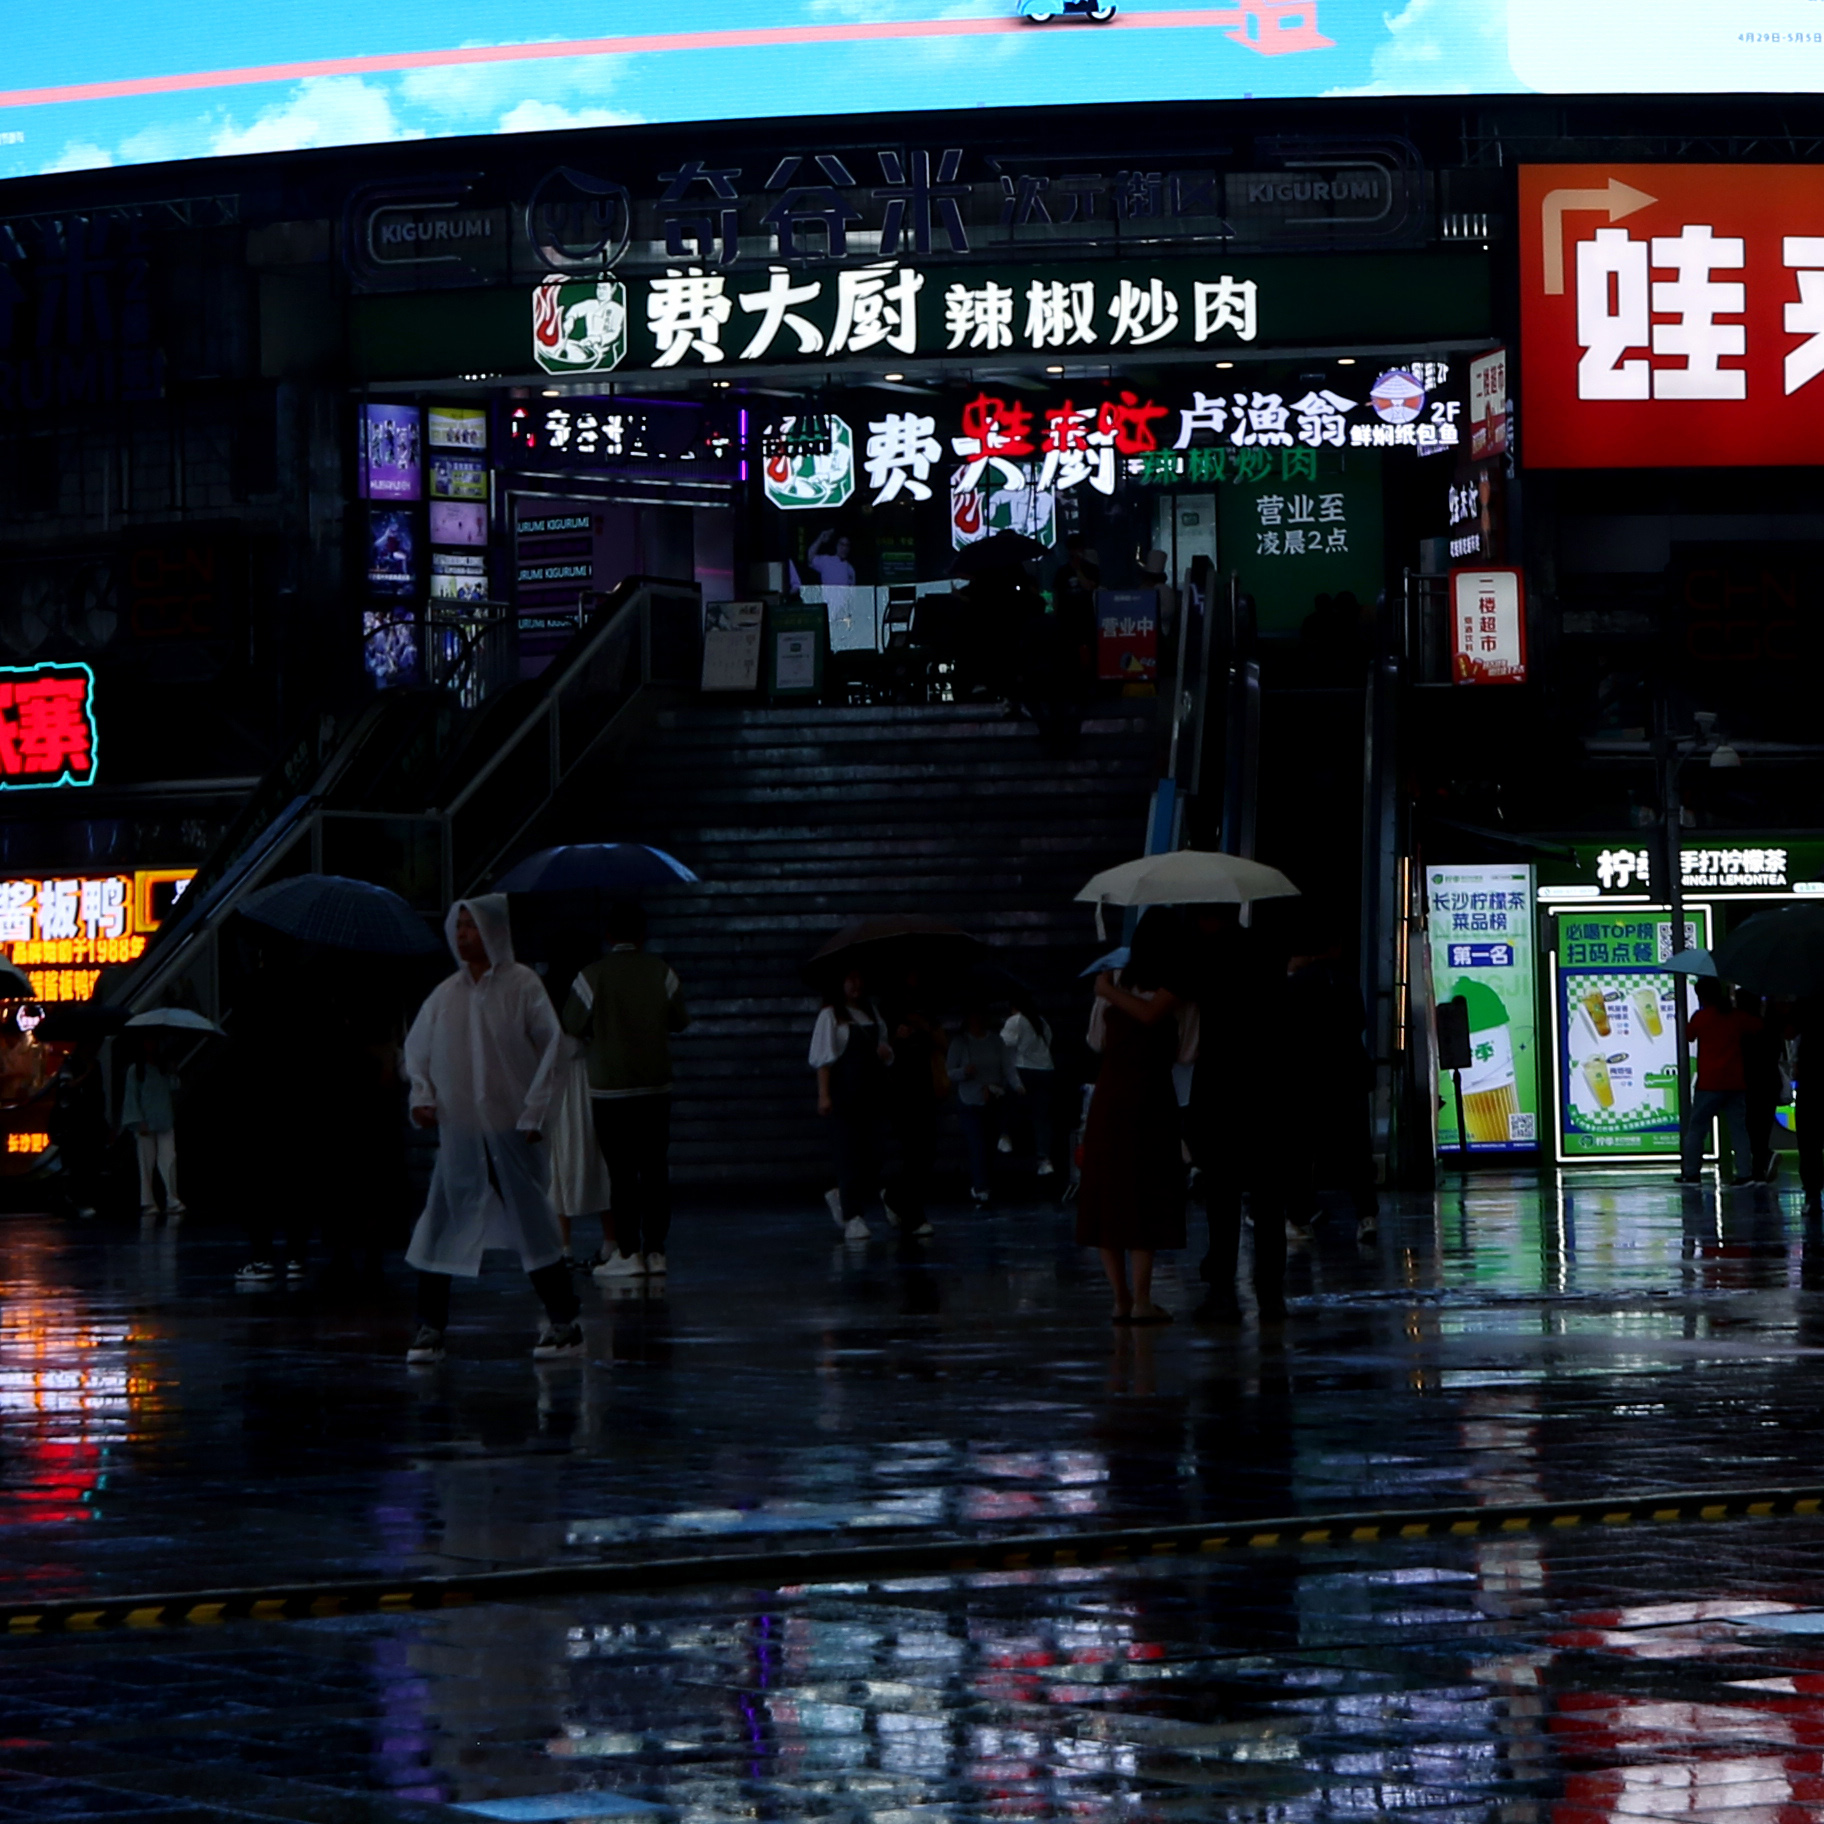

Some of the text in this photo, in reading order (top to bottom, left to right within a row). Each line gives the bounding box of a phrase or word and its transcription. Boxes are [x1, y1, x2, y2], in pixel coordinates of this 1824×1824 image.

[1248, 180, 1379, 204] KIGURUMI
[653, 148, 972, 266] 奇谷米
[381, 219, 492, 246] KIGURUMI
[646, 260, 925, 369] 费大厨
[944, 274, 1259, 351] 辣椒炒肉
[1431, 400, 1462, 422] 2F
[1256, 493, 1347, 526] 营业至
[1256, 528, 1350, 557] 凌晨2点
[1101, 616, 1156, 639] 营业中
[1679, 848, 1788, 873] 手打柠檬茶
[1432, 891, 1525, 912] 长沙柠檬茶
[1452, 912, 1508, 932] 菜品榜
[1453, 945, 1509, 966] 第一名
[1567, 942, 1654, 965] 扫码点餐
